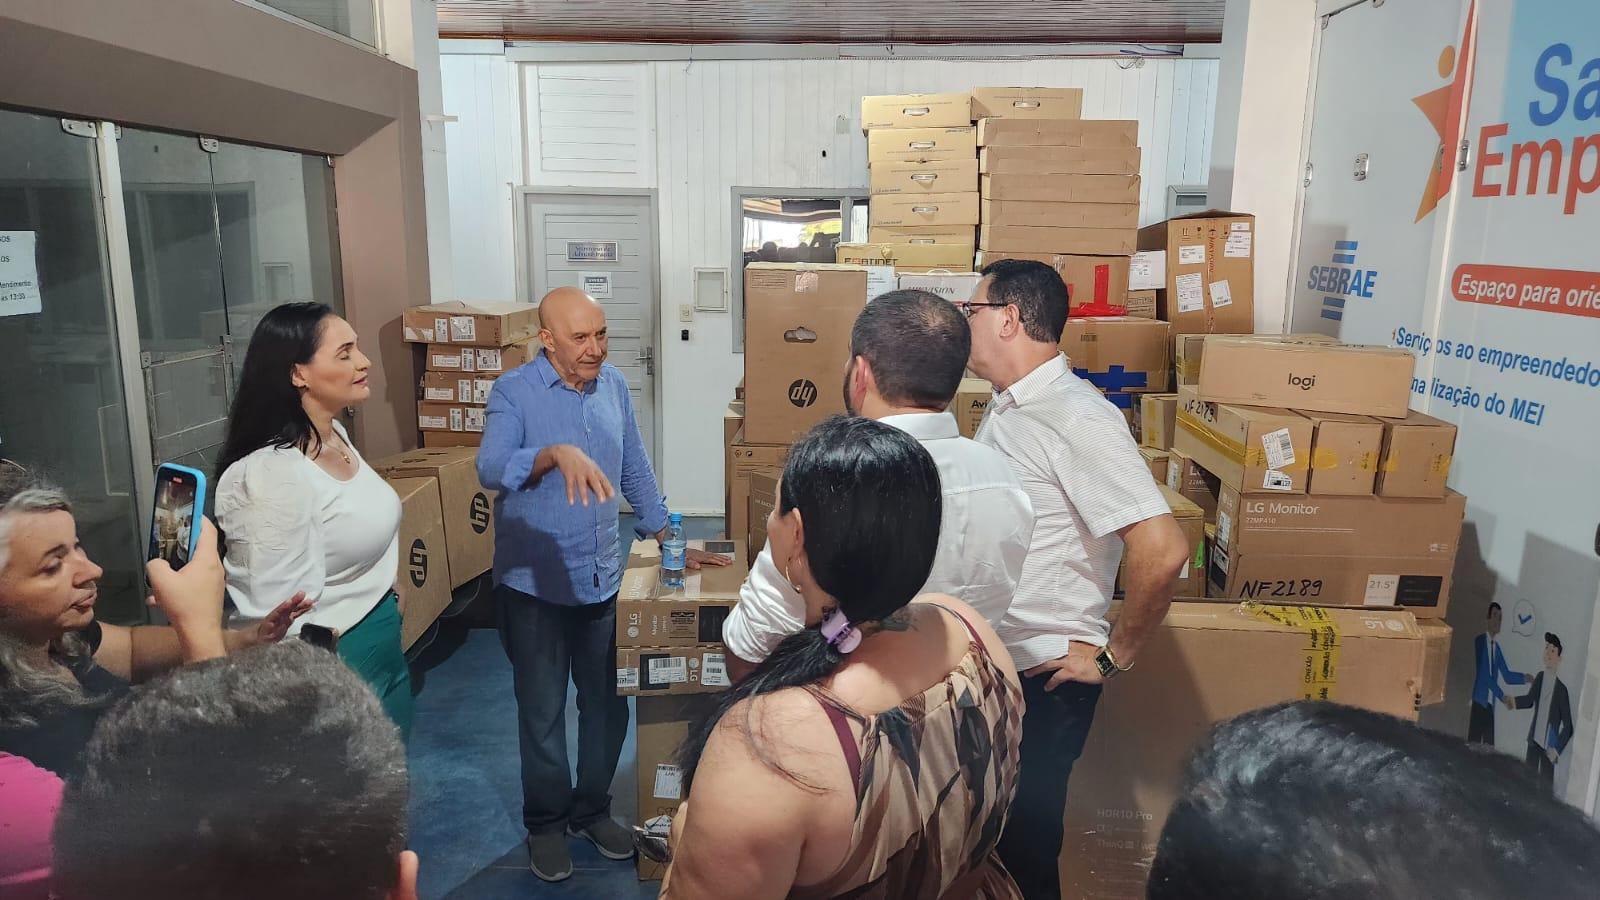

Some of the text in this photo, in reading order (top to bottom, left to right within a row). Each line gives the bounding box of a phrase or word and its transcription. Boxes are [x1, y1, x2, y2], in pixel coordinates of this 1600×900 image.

[1529, 43, 1600, 127] Sa
[1472, 122, 1600, 215] Emp
[1307, 265, 1377, 298] SEBRAE
[1458, 273, 1600, 310] Espaço para orie
[1455, 341, 1474, 360] ao
[1288, 373, 1316, 390] logi
[1484, 393, 1505, 415] do
[1509, 397, 1545, 426] MEI
[1246, 502, 1320, 514] LG Monitor
[629, 613, 638, 625] LG
[1365, 620, 1385, 630] LG
[690, 669, 698, 681] LG
